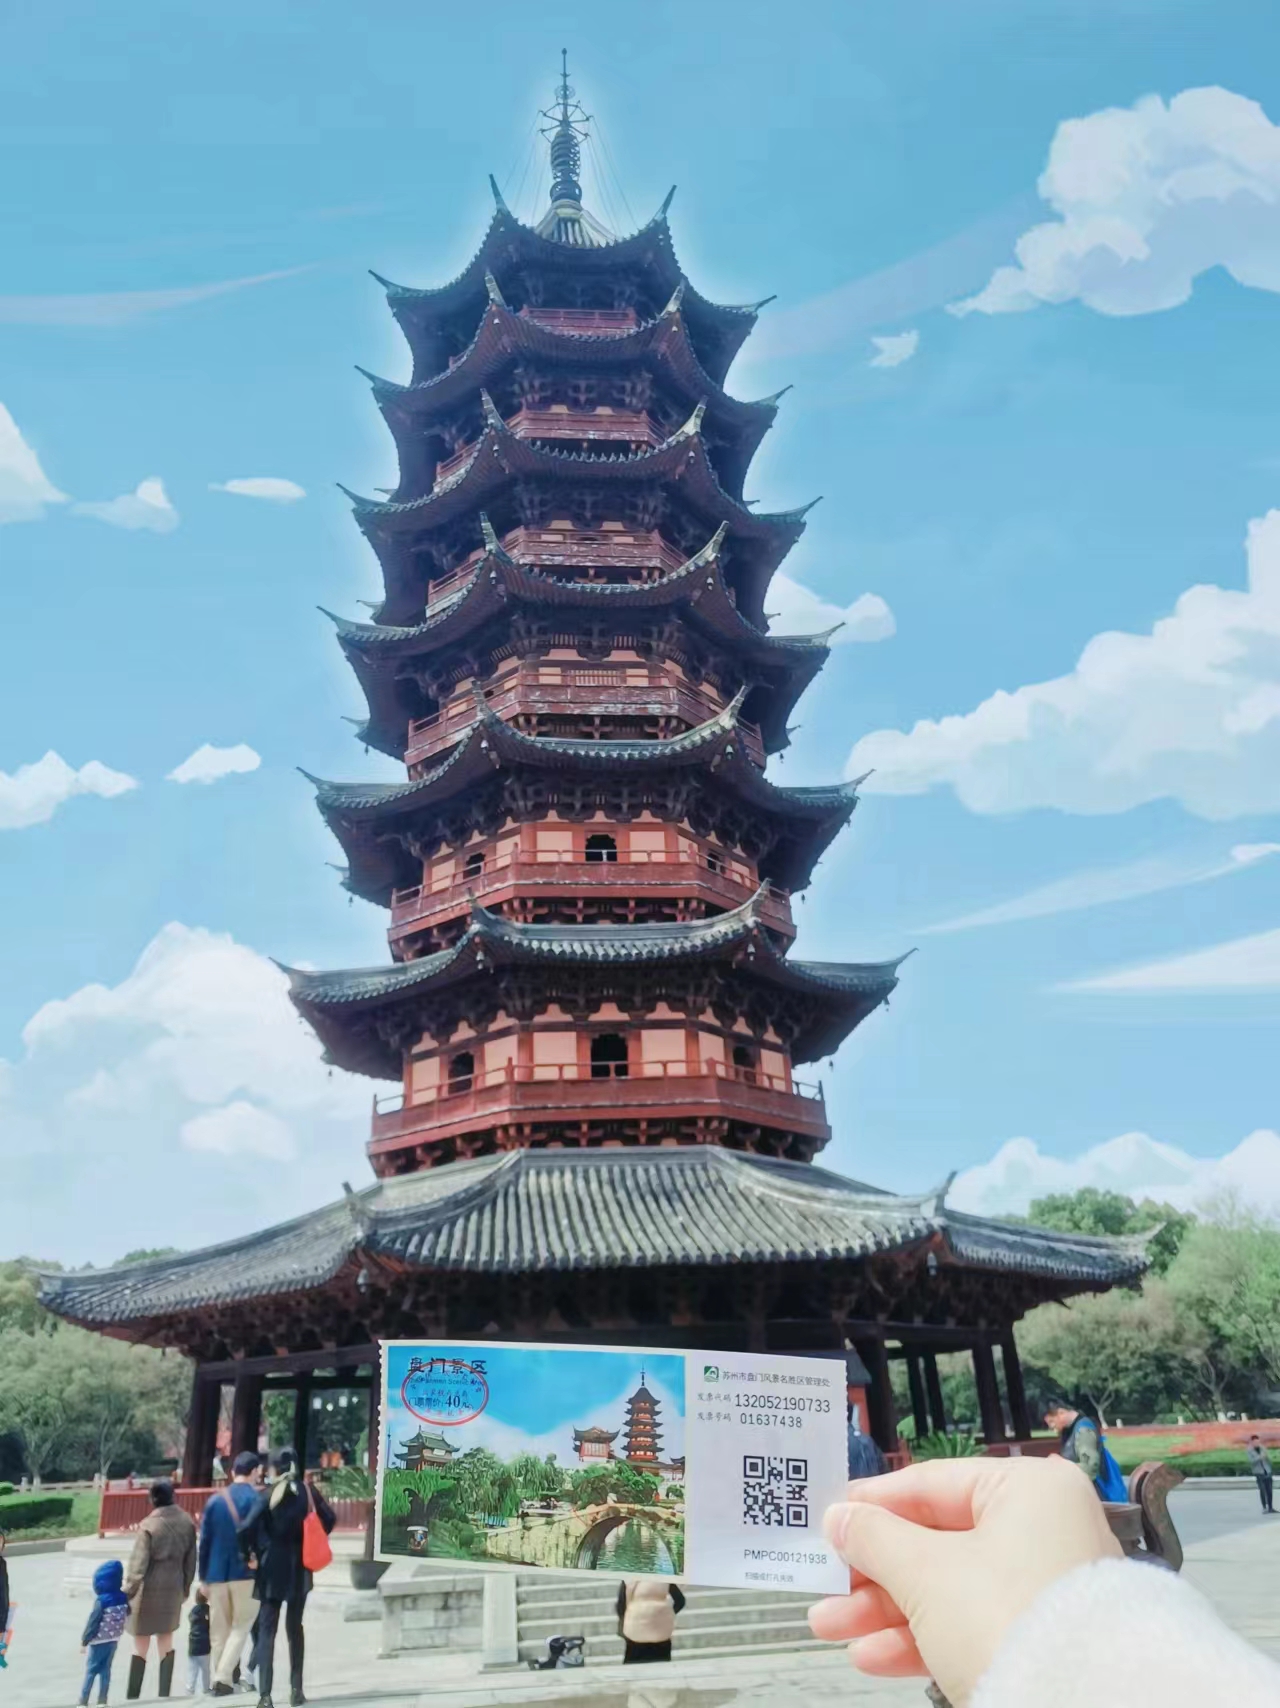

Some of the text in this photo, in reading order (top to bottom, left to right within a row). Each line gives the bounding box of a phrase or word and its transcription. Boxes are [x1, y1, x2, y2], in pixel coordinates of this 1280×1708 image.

[408, 1357, 487, 1375] 盘门景区
[722, 1371, 831, 1388] 苏州市盘门风景名胜区管理处
[697, 1393, 831, 1413] 发票代码 132052190733
[697, 1412, 802, 1428] 发票号码 01637438
[744, 1549, 827, 1564] PMPC00121938
